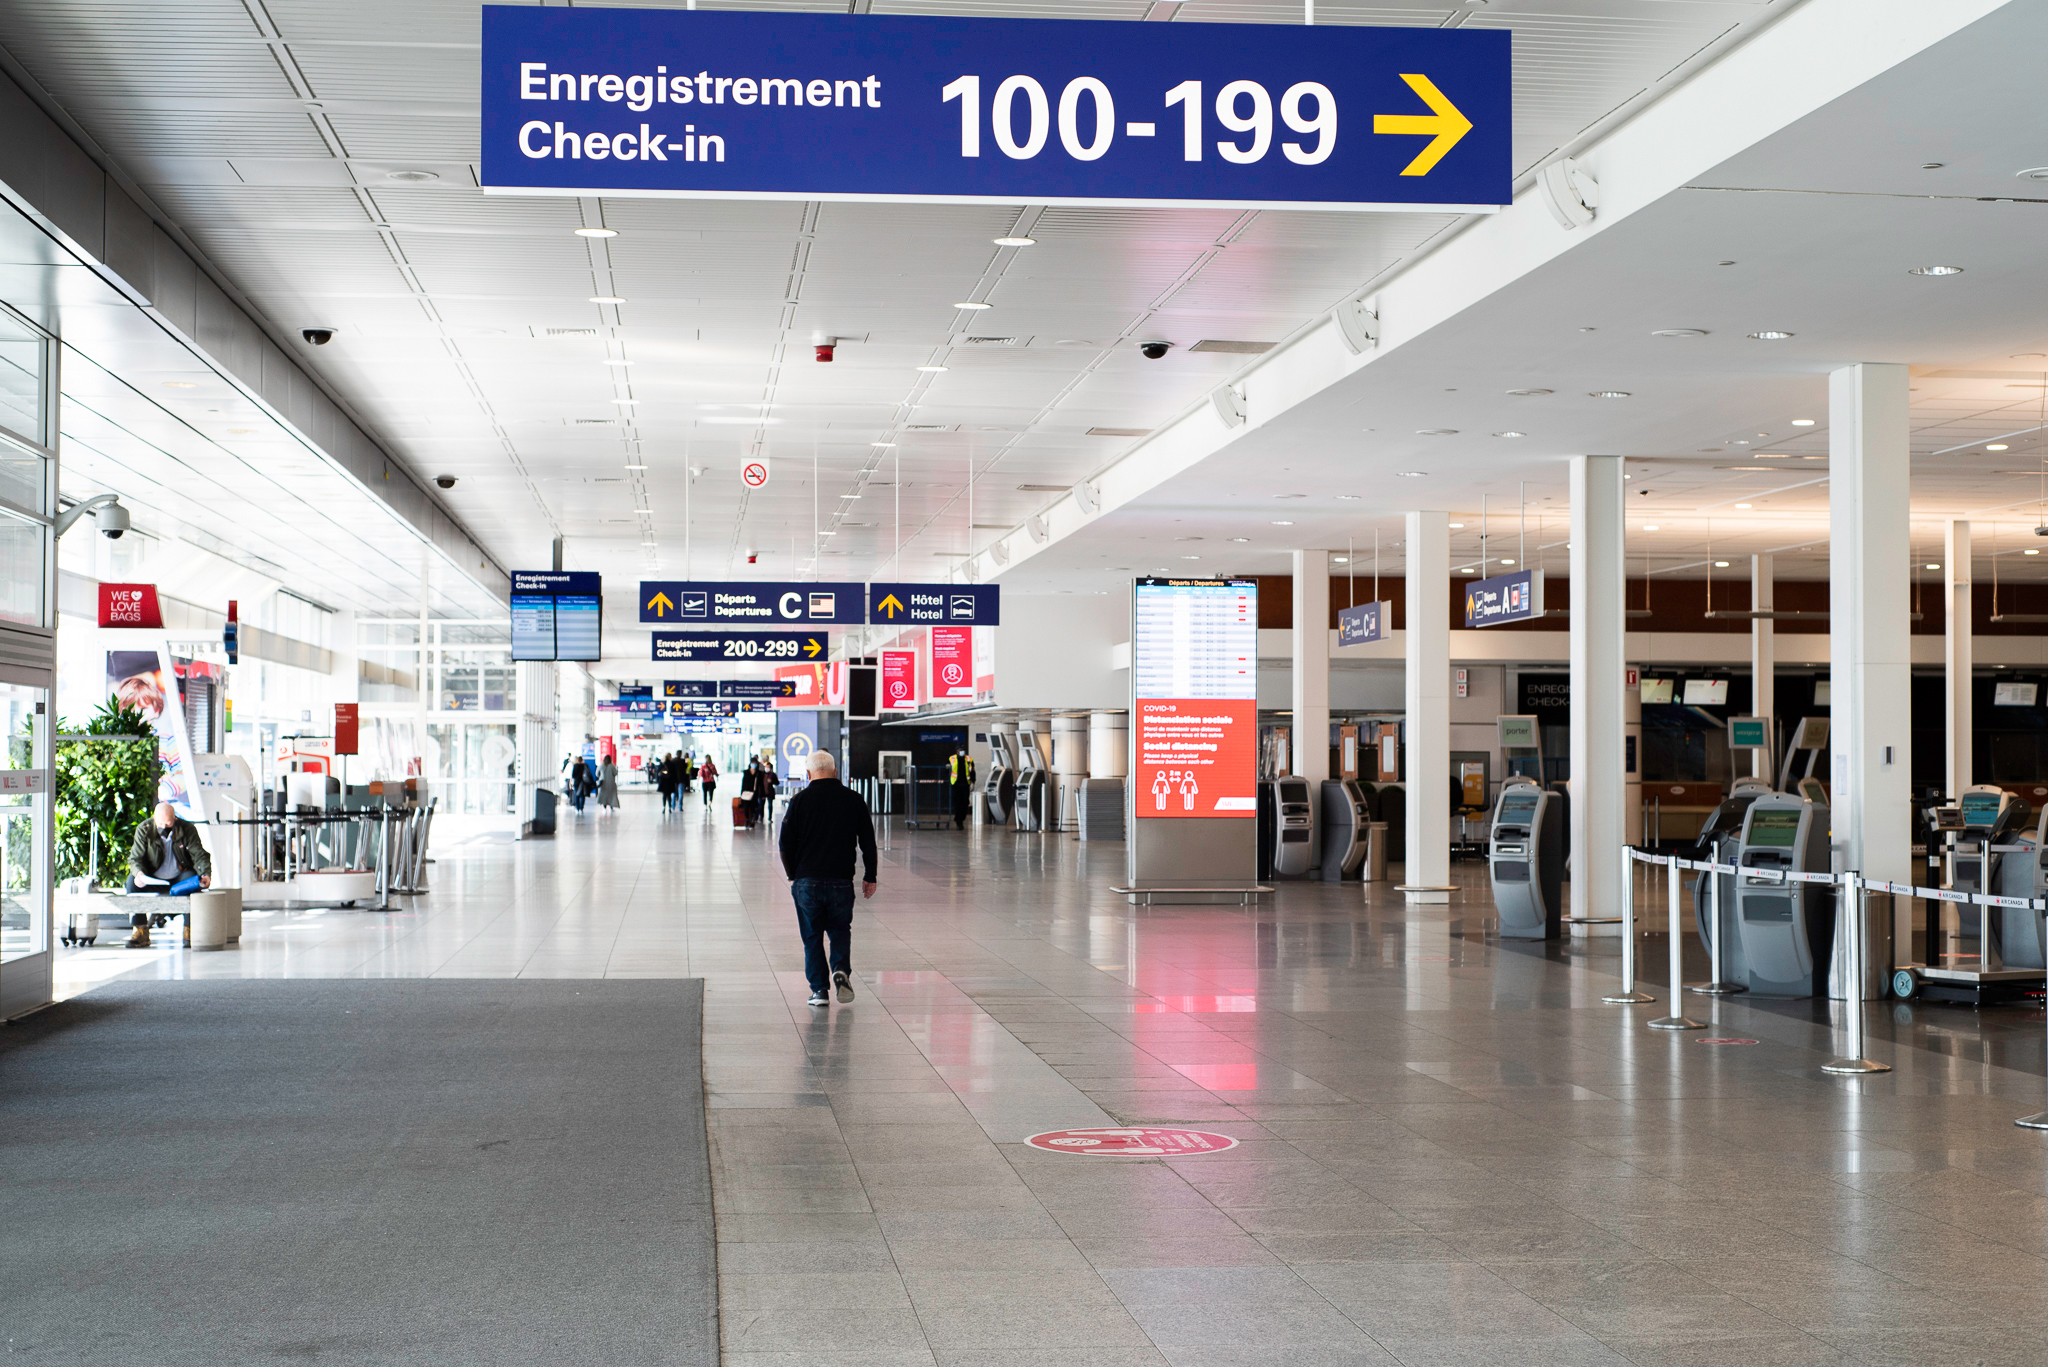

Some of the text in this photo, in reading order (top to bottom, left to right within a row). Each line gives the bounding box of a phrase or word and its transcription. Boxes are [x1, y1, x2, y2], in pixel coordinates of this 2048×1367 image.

[519, 62, 881, 112] Enregistrement
[942, 74, 1338, 166] 100-199
[518, 120, 725, 163] Check-in
[515, 574, 570, 583] Enregistrement
[515, 582, 547, 590] Check-in
[1194, 580, 1224, 588] Departures
[111, 591, 130, 601] WE
[714, 593, 757, 606] Départs
[911, 594, 943, 605] Hôtel
[1484, 591, 1497, 602] Départs
[1502, 586, 1510, 615] A
[110, 601, 141, 612] LOVE
[778, 591, 802, 619] C
[1484, 604, 1501, 616] Departures
[110, 612, 141, 621] BAGS
[714, 605, 773, 618] Departures
[911, 608, 943, 620] Hotel
[1351, 618, 1361, 628] Départs
[1363, 613, 1370, 637] C
[1351, 629, 1364, 638] Departures
[656, 639, 720, 650] Enregistrement
[723, 639, 799, 657] 200-299
[656, 649, 692, 658] Check-in
[629, 701, 638, 711] A
[712, 702, 721, 712] C
[1143, 715, 1233, 725] Distanciation sociale
[1506, 727, 1529, 736] porter
[1143, 742, 1218, 752] Social distancing
[1895, 885, 1908, 893] CANADA
[2001, 898, 2024, 907] AIR CANADA
